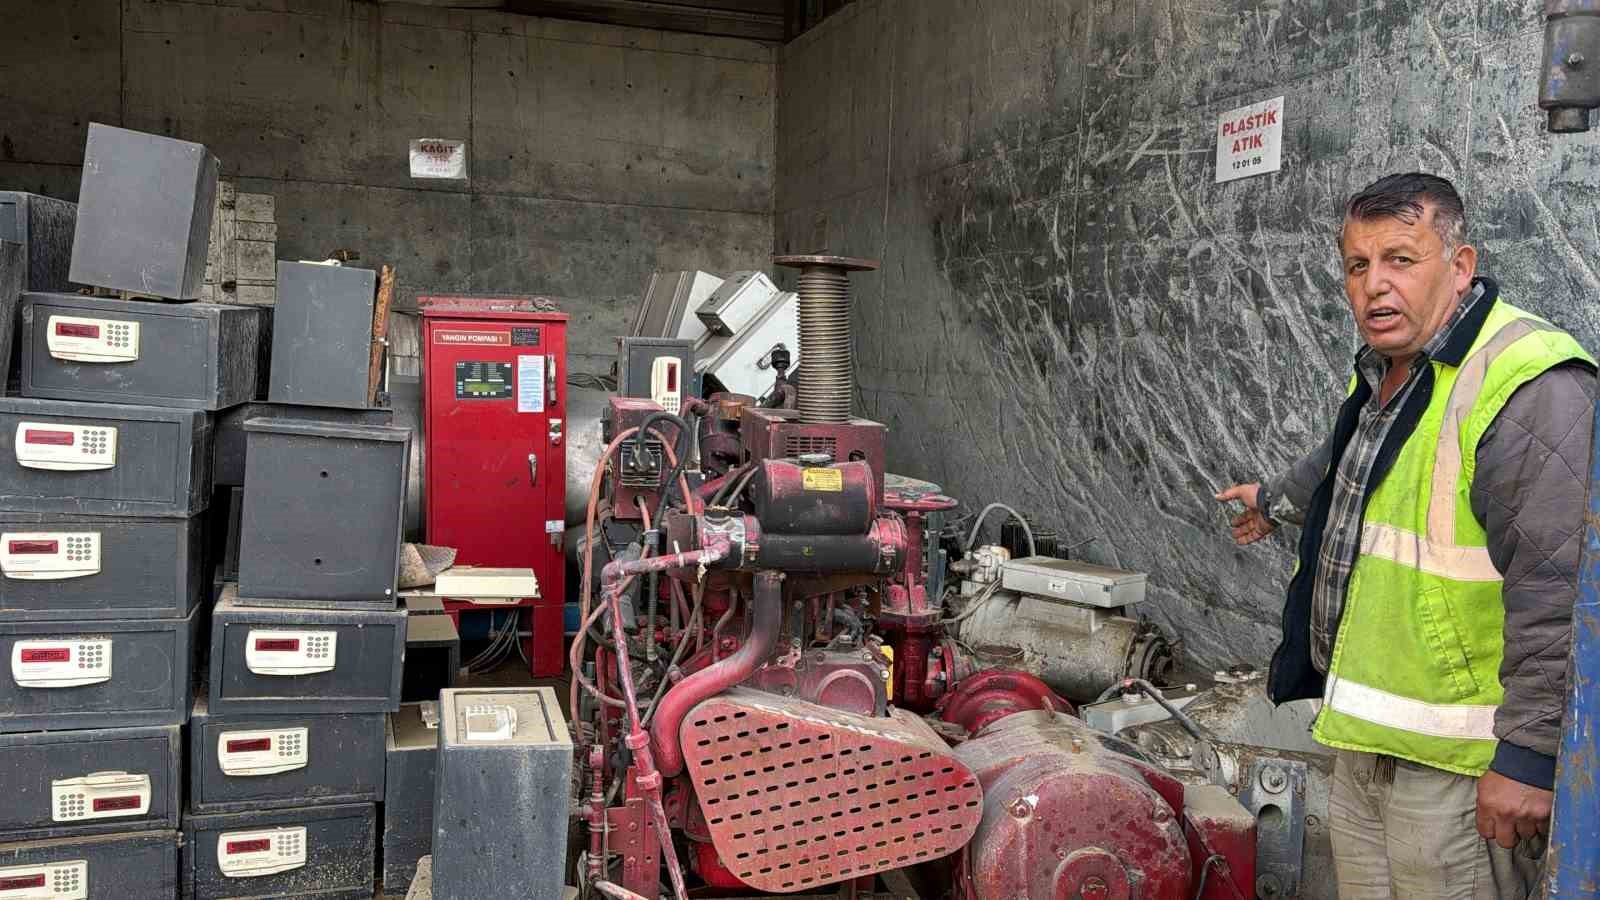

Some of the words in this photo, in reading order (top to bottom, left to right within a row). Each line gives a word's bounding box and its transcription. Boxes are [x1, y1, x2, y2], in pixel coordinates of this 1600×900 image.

[1222, 109, 1277, 136] PLASTİK
[421, 143, 455, 153] KAĞIT
[1232, 134, 1262, 154] ATIK
